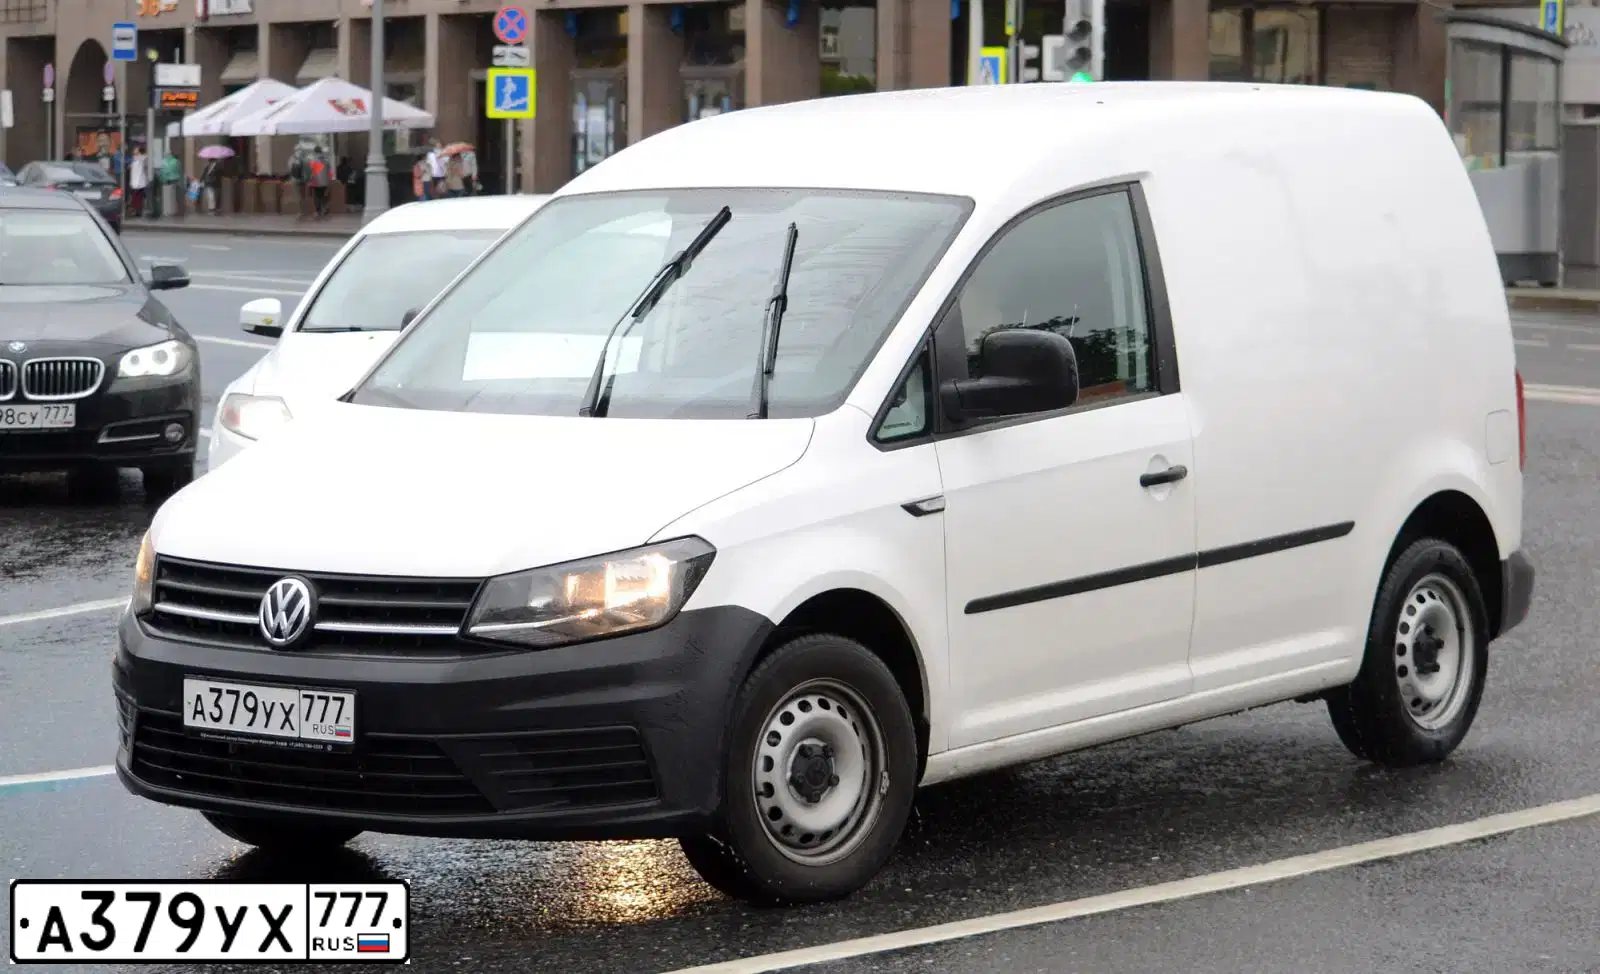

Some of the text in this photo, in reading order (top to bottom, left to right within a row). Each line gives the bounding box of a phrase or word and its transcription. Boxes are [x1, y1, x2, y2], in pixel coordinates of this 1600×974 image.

[43, 406, 69, 420] 777
[302, 694, 345, 724] 777
[312, 723, 334, 735] RUS
